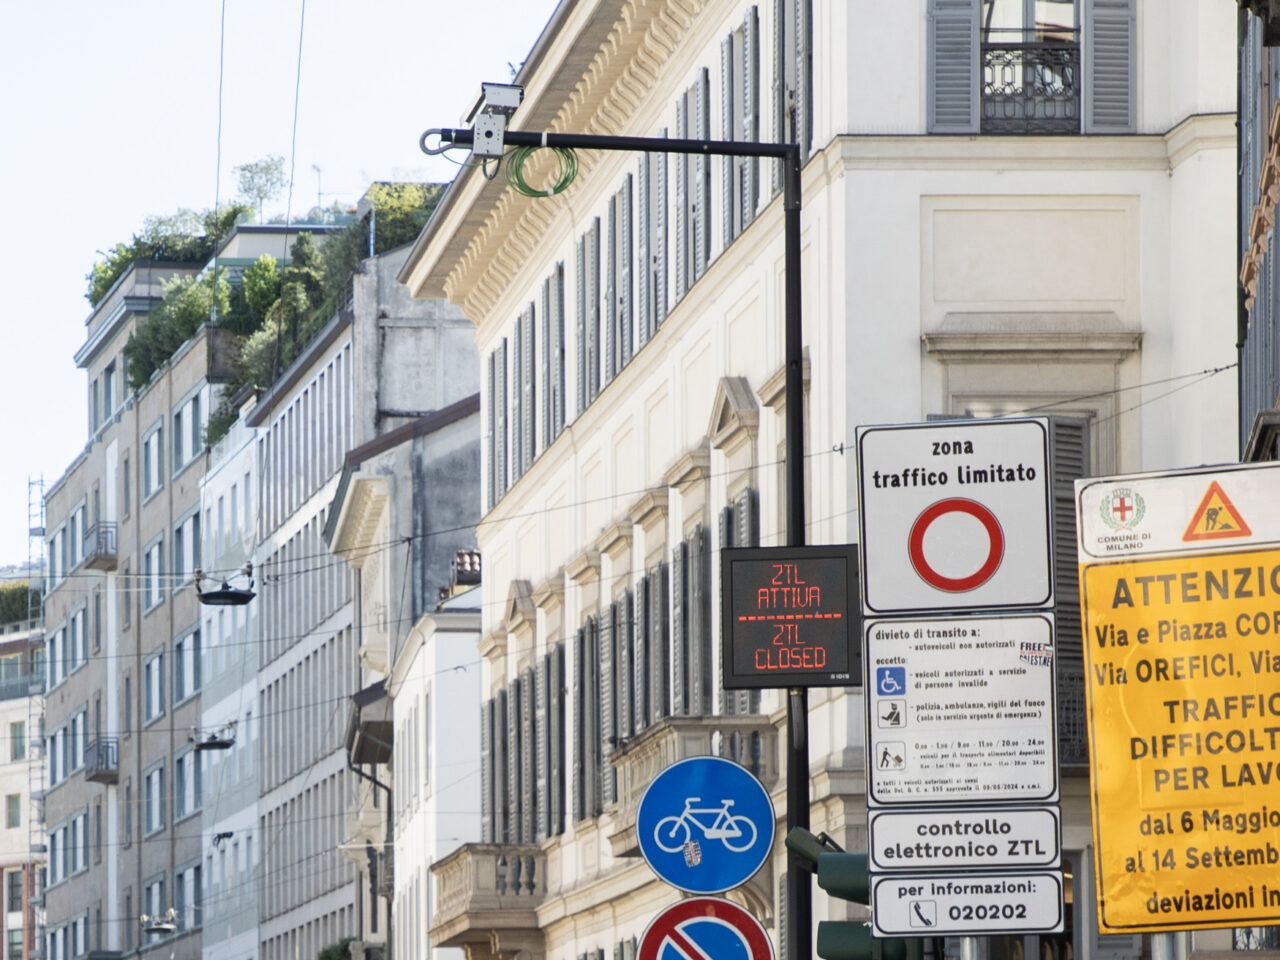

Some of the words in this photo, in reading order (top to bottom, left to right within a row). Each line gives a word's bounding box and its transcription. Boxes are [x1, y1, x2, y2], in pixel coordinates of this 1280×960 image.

[932, 440, 974, 456] zona
[873, 468, 948, 488] traffico
[958, 463, 1036, 484] limitato
[1097, 535, 1139, 544] COMUNE
[1106, 542, 1143, 551] MILANO
[772, 564, 806, 585] ZTL
[758, 586, 821, 609] ATTIVA
[773, 624, 807, 645] ZTL
[876, 629, 910, 640] divieto
[914, 628, 923, 639] di
[927, 627, 967, 638] transito
[971, 628, 981, 637] a:
[1095, 624, 1129, 648] Via
[1137, 627, 1150, 645] e
[1158, 619, 1227, 643] Piazza
[915, 641, 956, 651] autoveicoli
[976, 640, 1016, 649] autorizzati
[1020, 642, 1042, 651] FREE
[755, 647, 826, 669] CLOSED
[876, 657, 908, 665] eccetto:
[915, 670, 940, 678] veicoli
[945, 669, 985, 677] autorizzati
[999, 667, 1027, 676] servizio
[1094, 662, 1128, 686] Via
[1136, 652, 1242, 683] OREFICI,
[925, 682, 953, 690] persone
[958, 680, 988, 688] invalide
[988, 700, 1007, 709] vigili
[1010, 700, 1022, 708] del
[1025, 699, 1045, 707] fuoco
[944, 712, 968, 721] servizio
[970, 713, 994, 722] urgente
[1130, 727, 1280, 760] DIFFICOLT
[1154, 766, 1210, 792] PER
[917, 819, 1012, 836] controllo
[1140, 813, 1174, 836] dal
[1181, 811, 1194, 833] 6
[1203, 806, 1280, 835] Maggio
[884, 842, 998, 859] elettronico
[1008, 840, 1046, 856] ZTL
[1125, 851, 1145, 873] al
[1153, 849, 1176, 871] 14
[1186, 843, 1279, 869] Settemb
[898, 886, 924, 899] per
[931, 880, 1037, 896] informazioni:
[1146, 885, 1254, 914] deviazioni
[949, 904, 1027, 921] 020202
